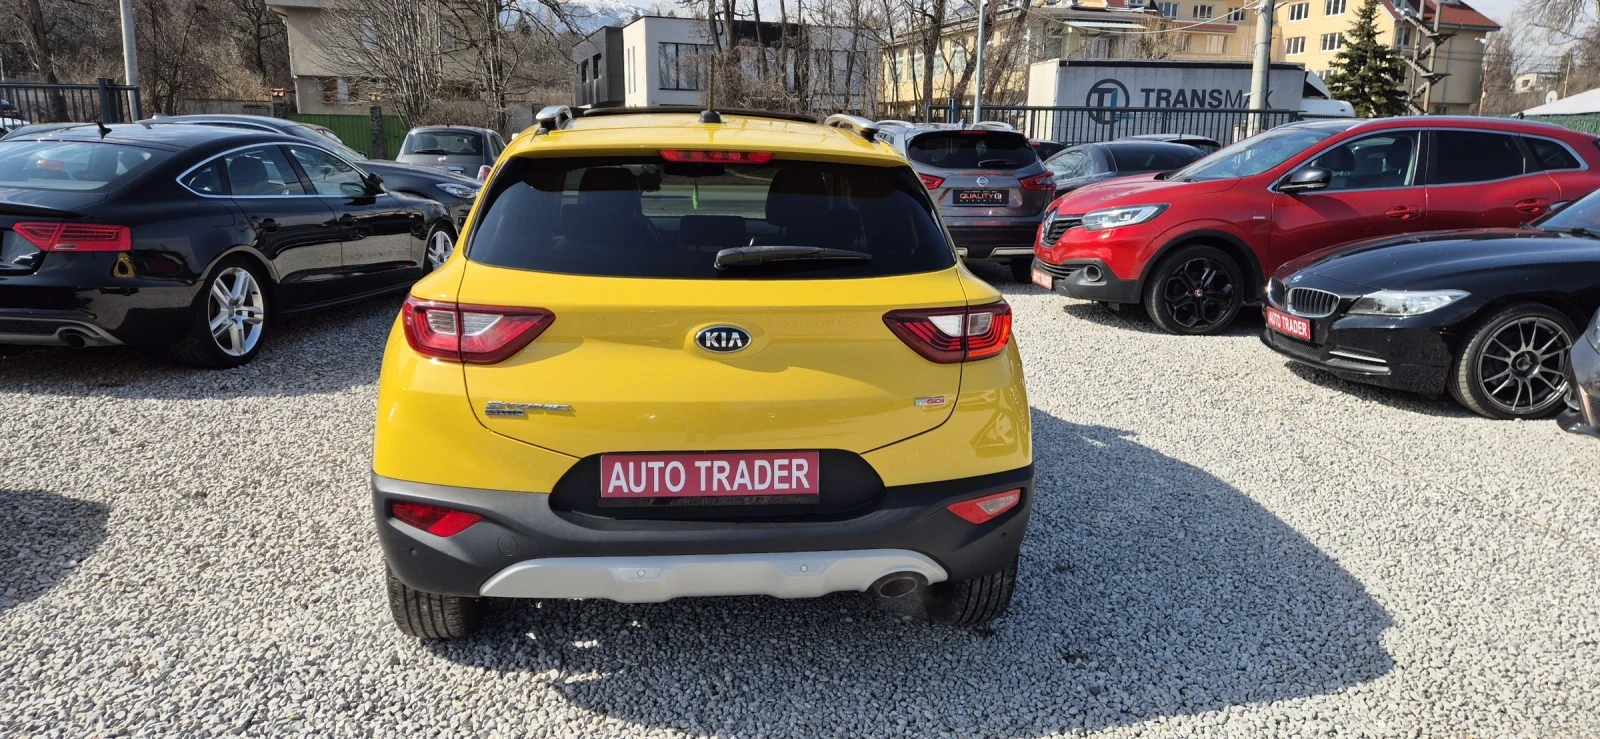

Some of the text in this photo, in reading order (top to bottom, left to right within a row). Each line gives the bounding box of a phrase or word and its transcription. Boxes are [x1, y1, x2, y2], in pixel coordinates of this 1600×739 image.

[1270, 310, 1308, 337] AUTO TRADER
[705, 331, 743, 347] KIA
[607, 458, 810, 493] AUTO TRADER
